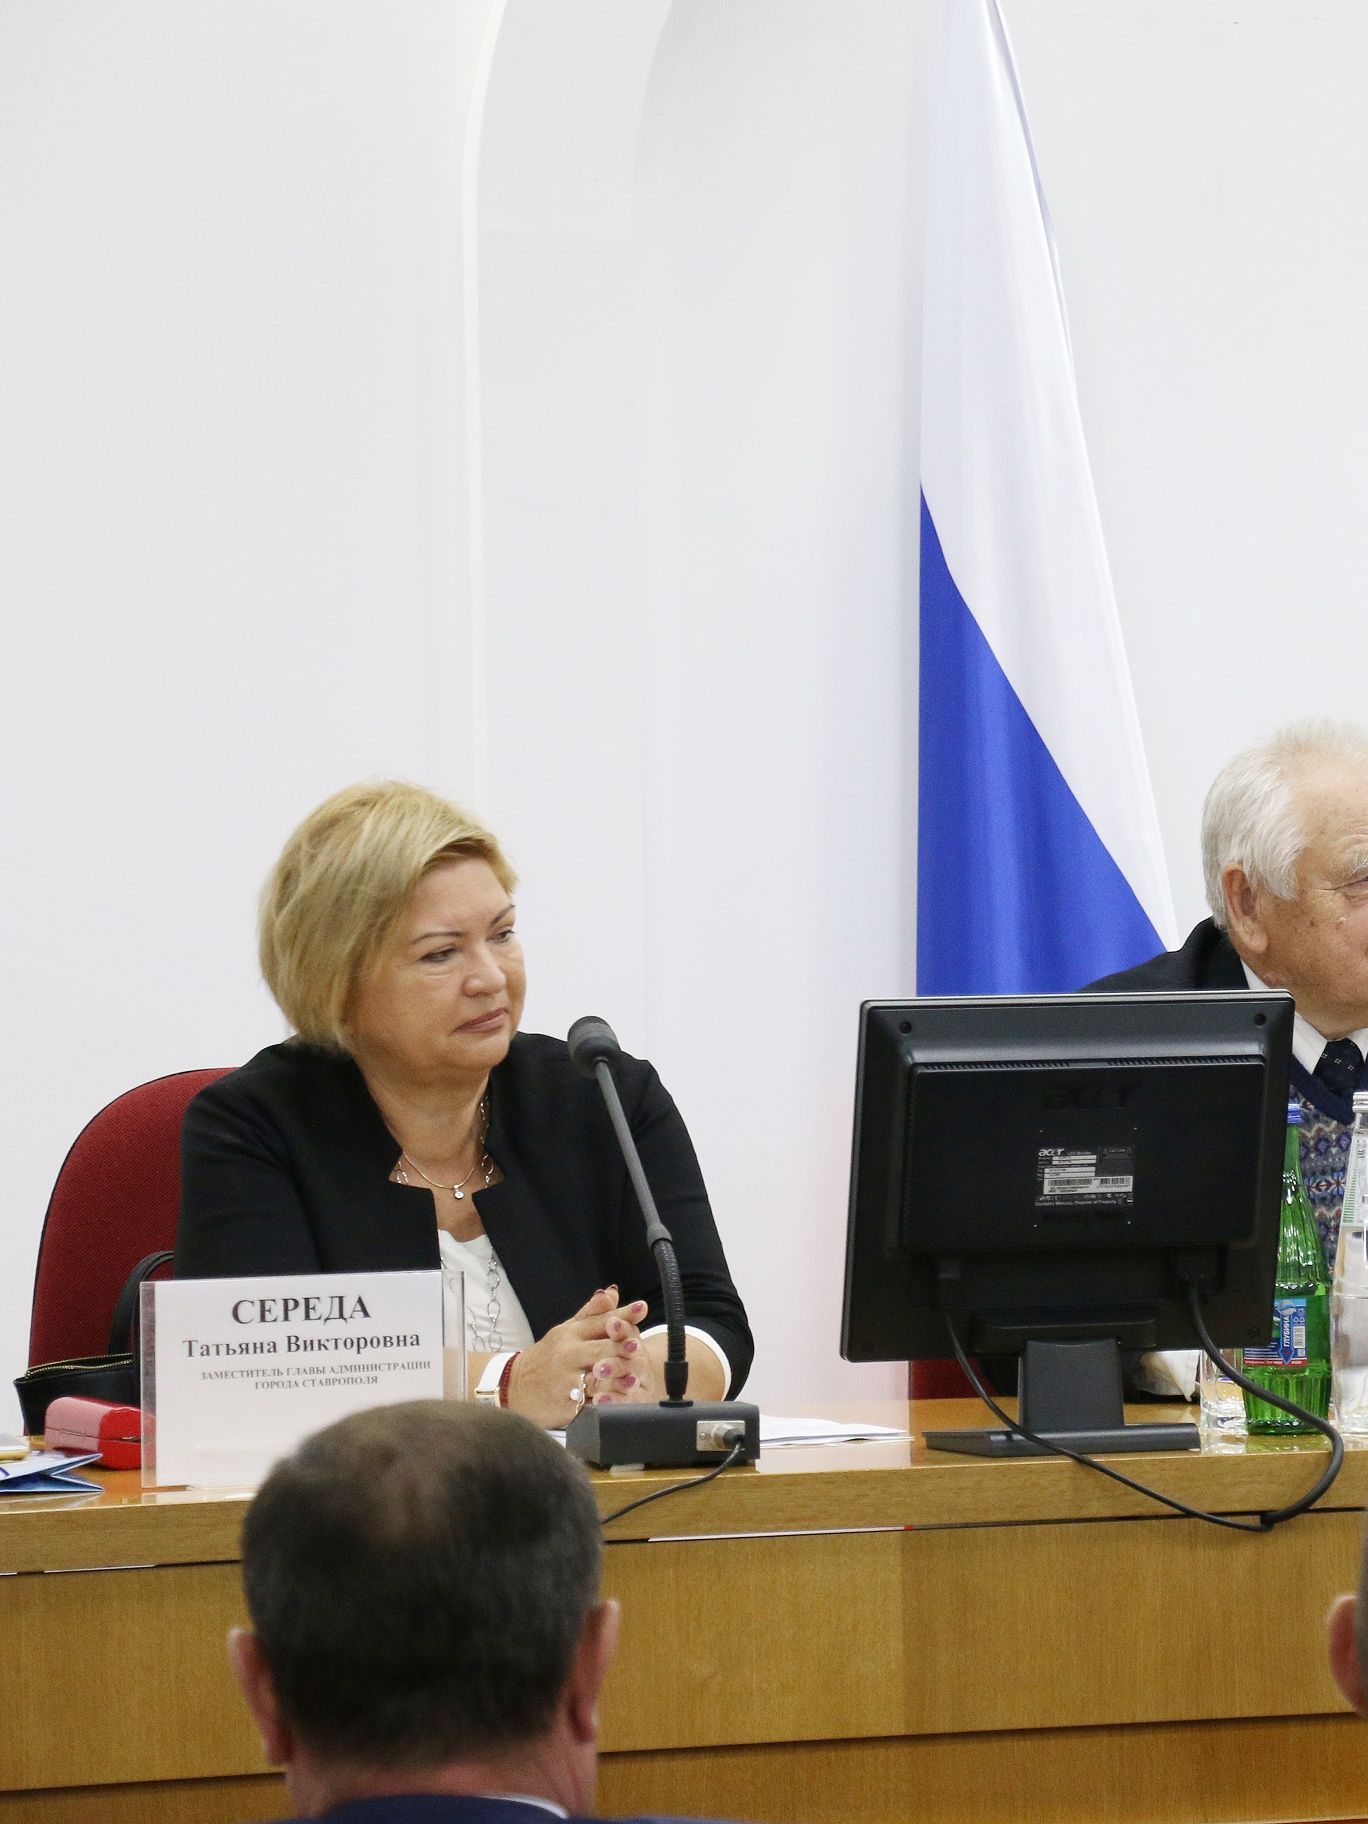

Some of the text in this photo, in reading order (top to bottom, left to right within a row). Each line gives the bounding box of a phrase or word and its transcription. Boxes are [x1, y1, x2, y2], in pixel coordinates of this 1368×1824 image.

[1038, 1148, 1065, 1156] acer
[232, 1295, 371, 1325] СЕРЕДА
[183, 1334, 420, 1357] Татьяна Викторовна
[201, 1361, 431, 1380] ЗАМЕСТИТЕЛЬ ГЛАВЫ АДМИНИСТРАЦИИ
[255, 1376, 378, 1390] ГОРОДА СТАВРОПОЛЯ
